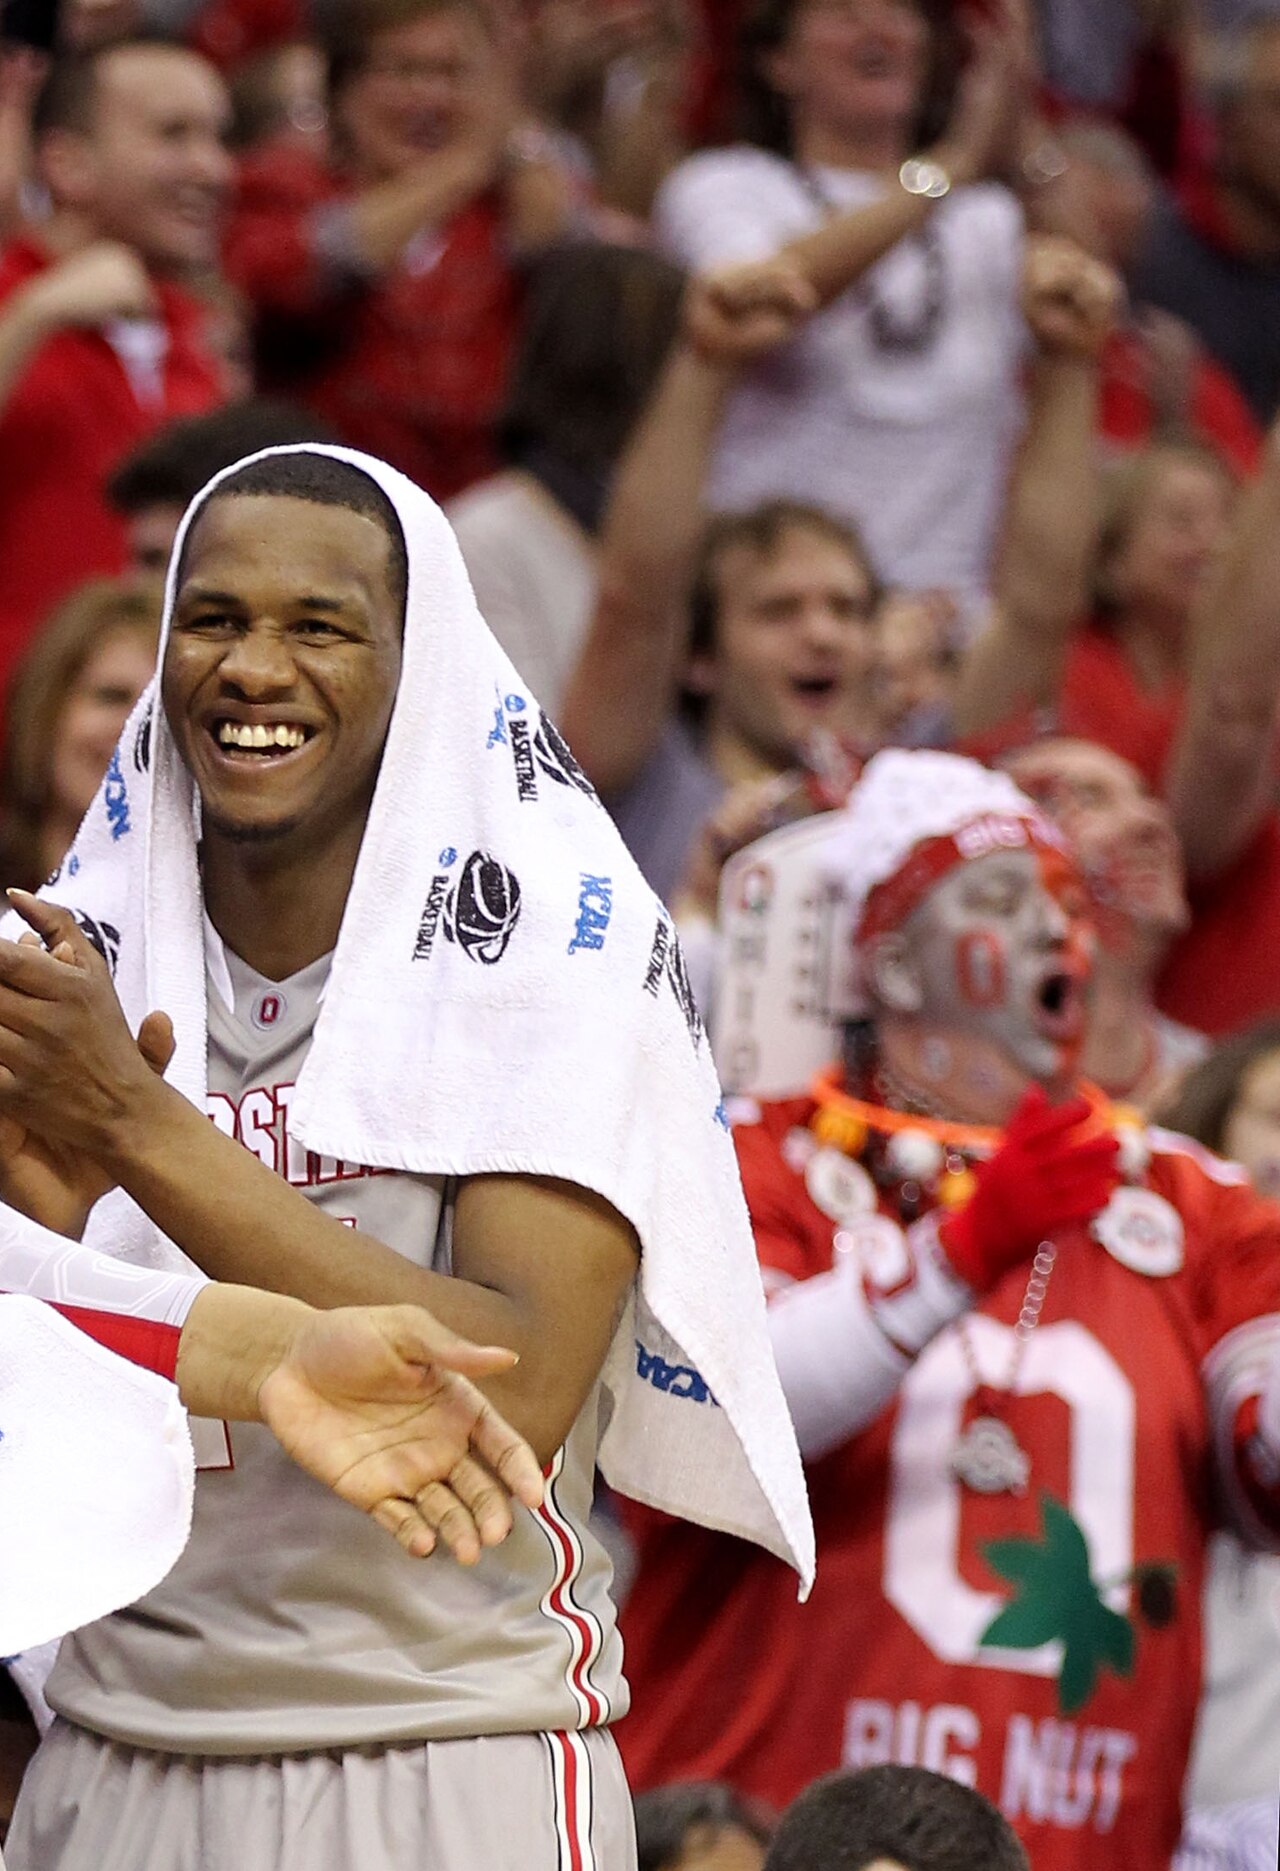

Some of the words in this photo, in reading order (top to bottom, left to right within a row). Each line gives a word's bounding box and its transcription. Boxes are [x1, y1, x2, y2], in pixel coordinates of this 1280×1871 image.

[508, 719, 538, 802] BASKETBALL
[412, 874, 450, 962] BASKETBALL
[566, 871, 613, 955] NCAA
[999, 1712, 1140, 1834] NUT
